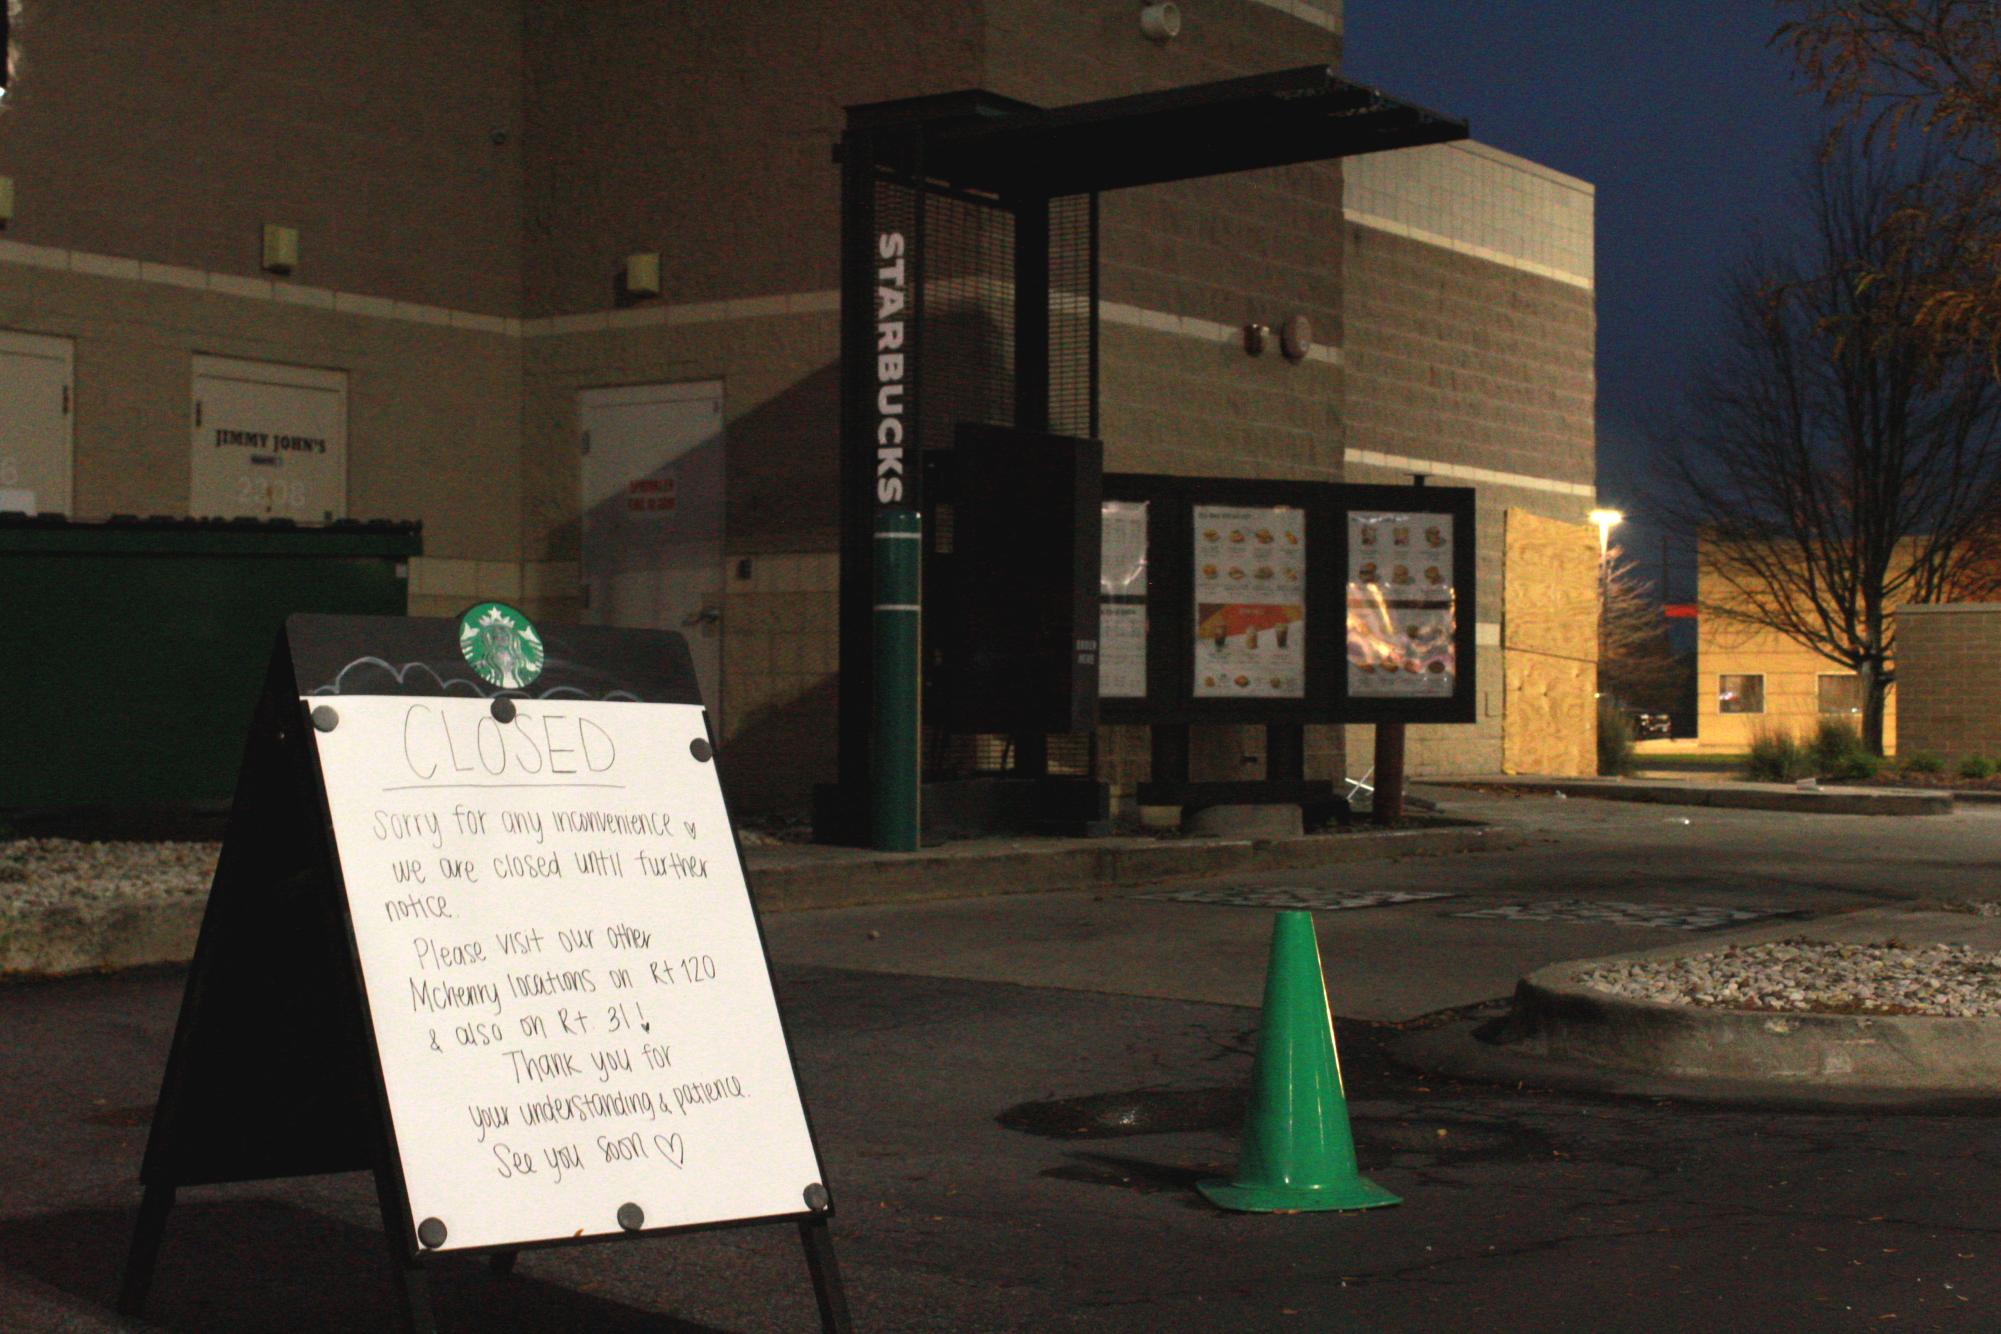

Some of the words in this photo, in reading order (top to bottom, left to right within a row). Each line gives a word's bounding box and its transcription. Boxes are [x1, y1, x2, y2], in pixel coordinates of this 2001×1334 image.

[876, 231, 905, 505] STARBUCKS
[215, 429, 268, 448] JIMMY
[272, 435, 326, 453] JOHN'S
[403, 704, 616, 780] CLOSED
[374, 808, 443, 849] Sorry
[452, 804, 487, 836] for
[501, 811, 544, 845] any
[552, 811, 673, 837] inconvenience
[392, 860, 427, 884] we
[438, 858, 479, 884] are
[493, 851, 563, 879] closed
[573, 850, 624, 879] until
[636, 850, 709, 880] further
[413, 937, 487, 970] Please
[496, 927, 545, 956] visit
[557, 928, 595, 953] our
[607, 923, 653, 950] other
[507, 968, 597, 998] locations
[609, 968, 634, 989] on
[649, 960, 676, 985] Rt
[681, 955, 717, 984] 120
[428, 1028, 443, 1054] &
[455, 1022, 504, 1046] also
[519, 1015, 548, 1039] on
[502, 1050, 583, 1084] Thank
[590, 1048, 633, 1083] you
[641, 1043, 673, 1071] for
[468, 1105, 510, 1144] your
[518, 1091, 656, 1127] understanding
[659, 1093, 673, 1115] &
[492, 1143, 538, 1179] See
[543, 1144, 586, 1184] you
